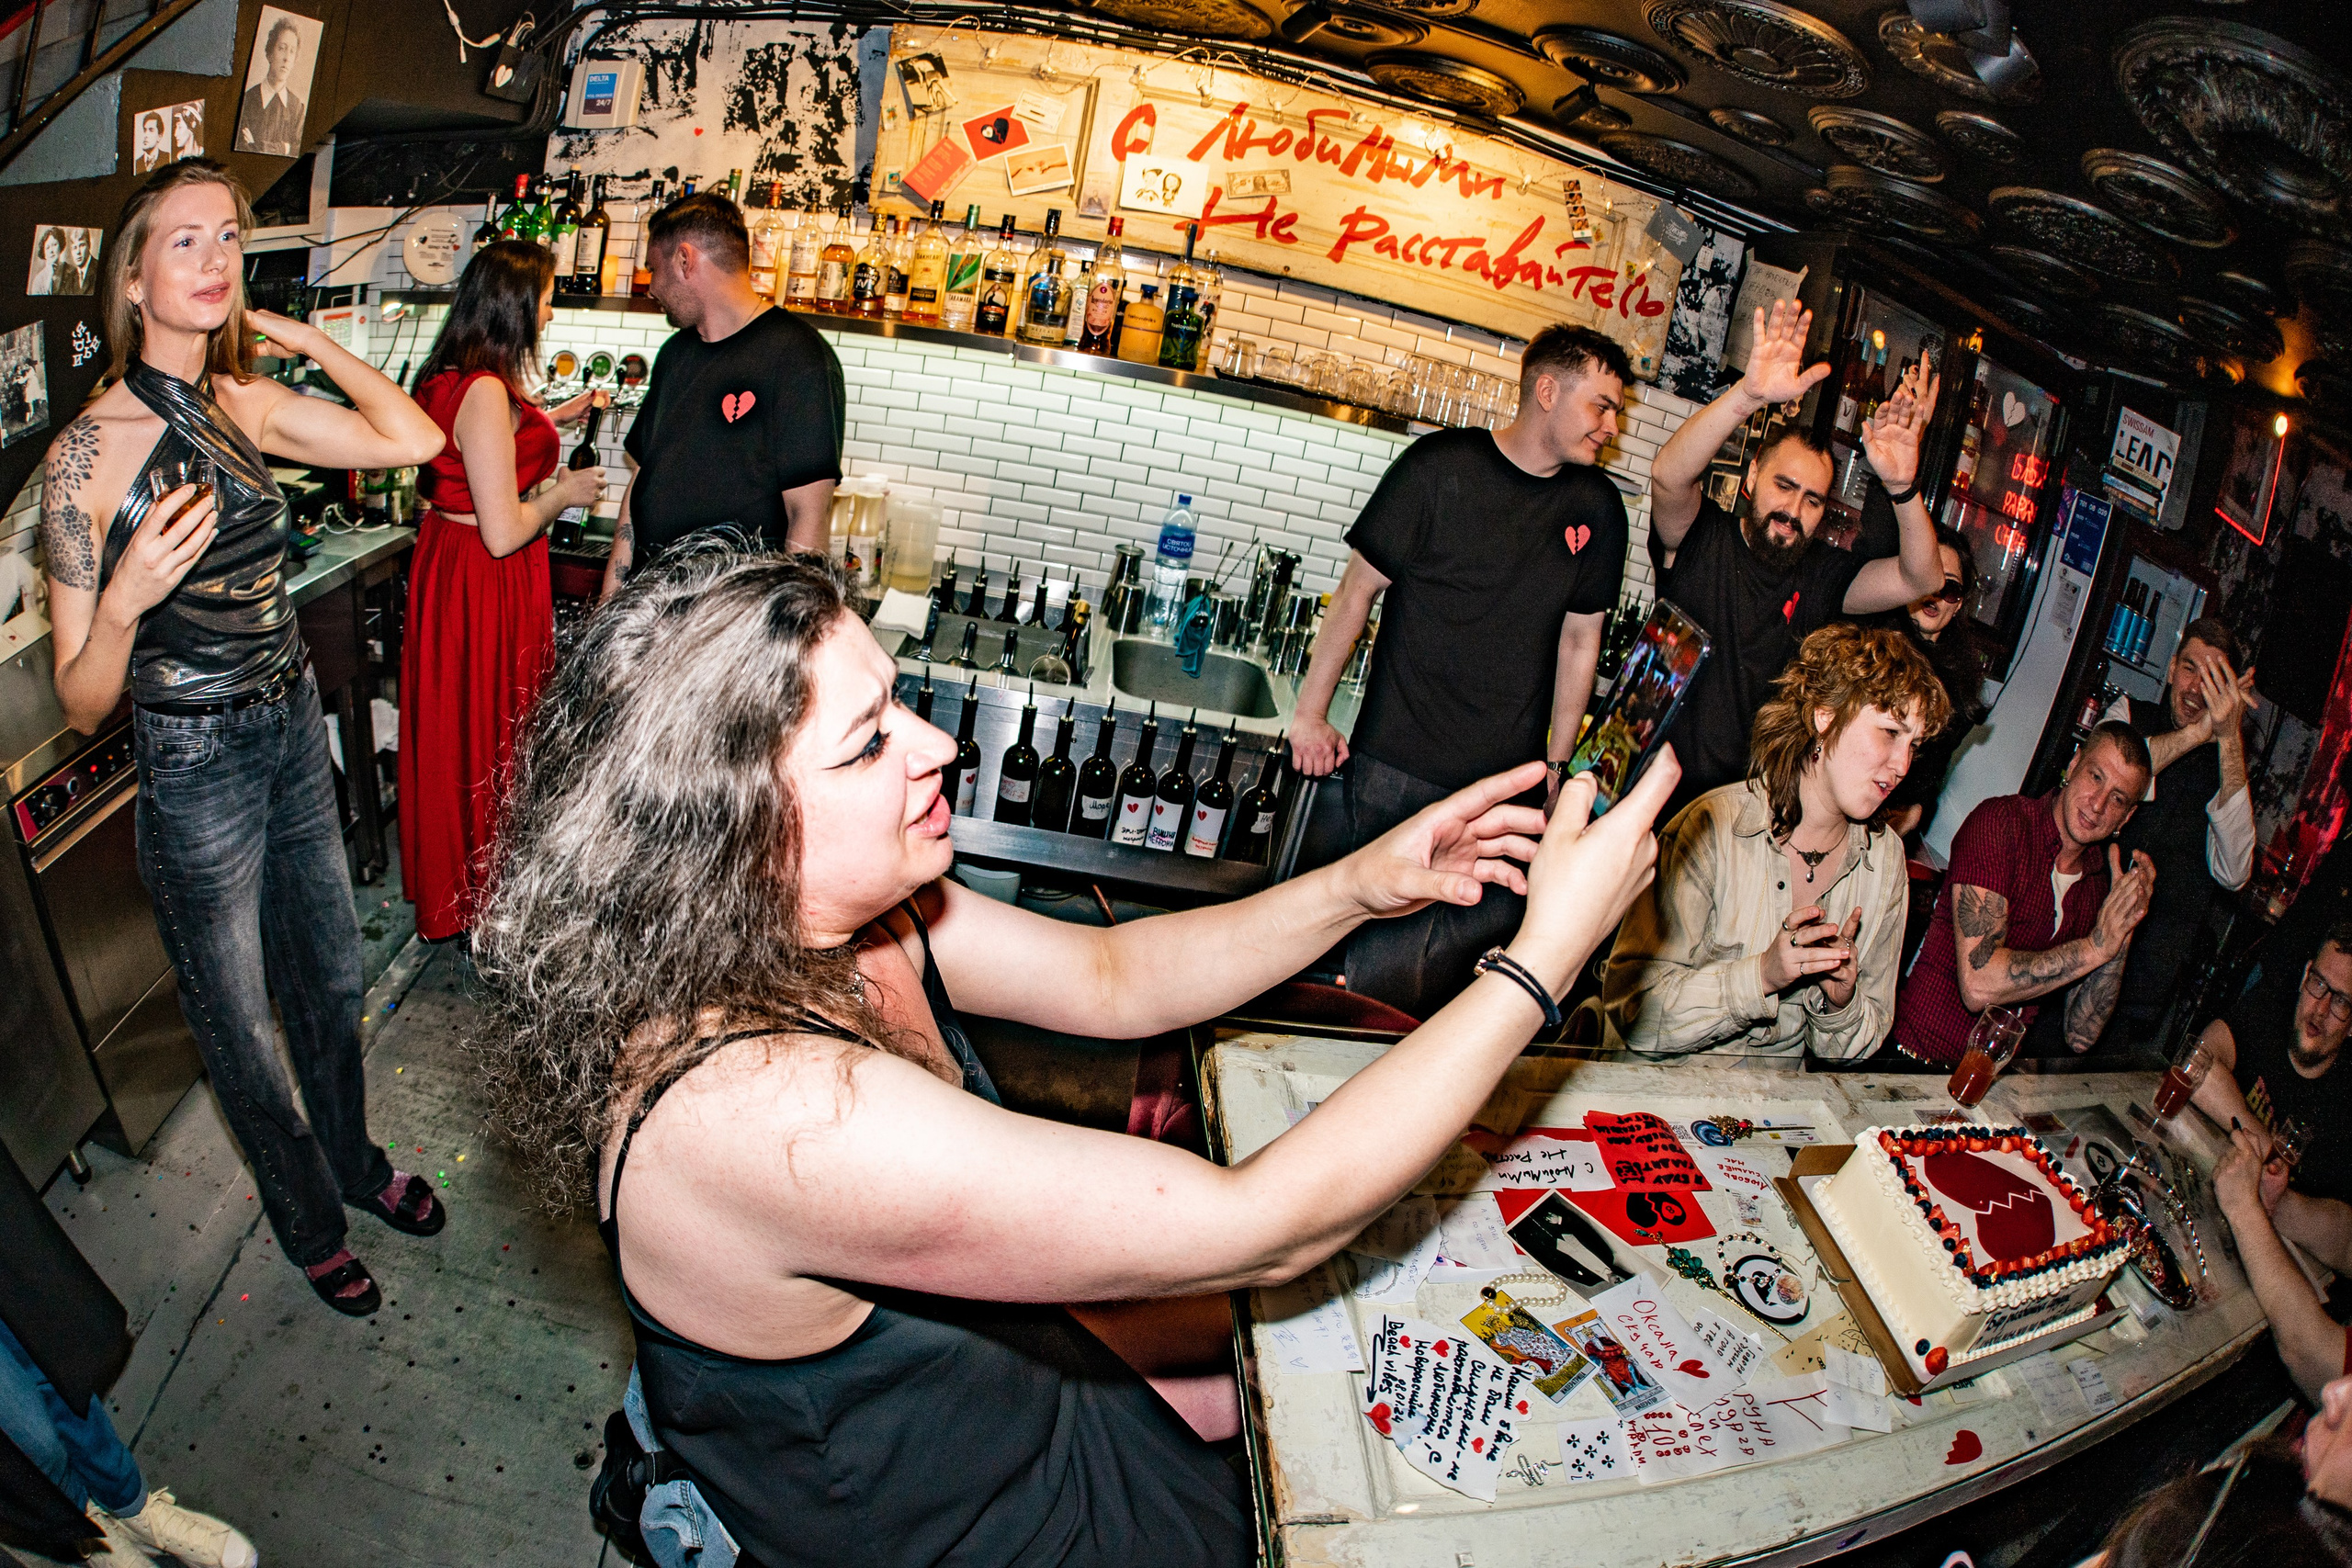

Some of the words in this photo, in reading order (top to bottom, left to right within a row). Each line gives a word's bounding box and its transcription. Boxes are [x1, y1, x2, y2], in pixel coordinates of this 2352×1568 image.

[1112, 103, 1156, 162] С
[1173, 186, 1299, 244] Не
[1326, 205, 1666, 320] Расставайтесь
[2122, 413, 2154, 438] SWISSAM
[1541, 1148, 1567, 1162] Не
[1584, 1162, 1594, 1174] С
[1723, 1156, 1745, 1167] НАС
[1724, 1172, 1769, 1191] ЛЮБОВЬ
[1385, 1320, 1406, 1357] Beach
[1633, 1300, 1679, 1362] Оксана
[1378, 1359, 1396, 1395] vibes
[1390, 1377, 1408, 1424] 08.01.24
[1634, 1395, 1659, 1413] ИМПЕРАТОР
